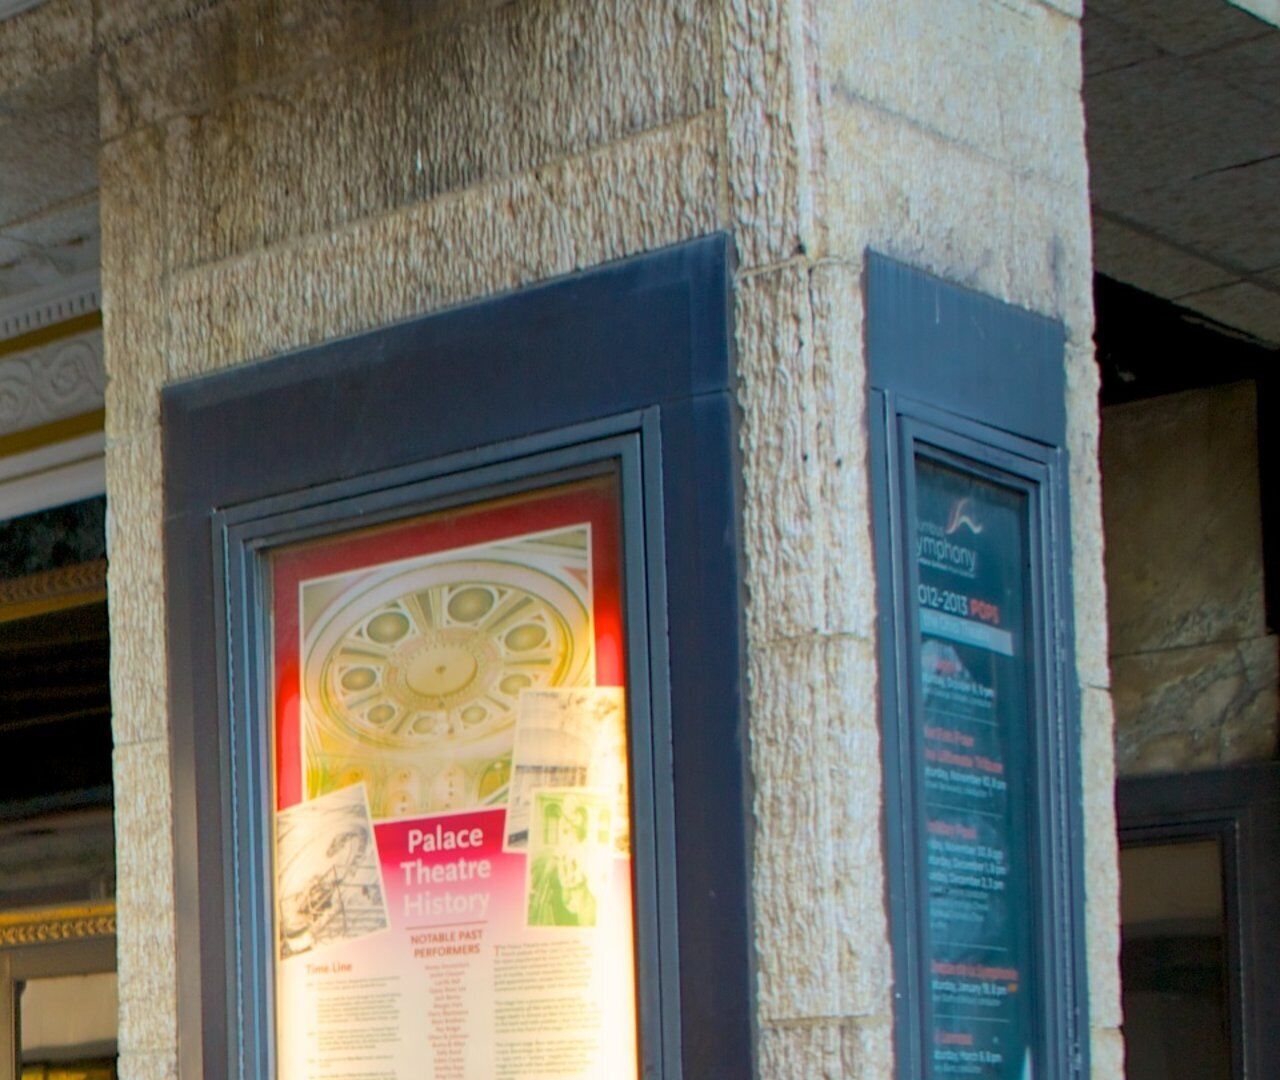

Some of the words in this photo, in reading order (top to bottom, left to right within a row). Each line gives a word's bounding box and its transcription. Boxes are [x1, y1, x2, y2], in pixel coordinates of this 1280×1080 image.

[917, 535, 977, 572] ymphony
[918, 584, 969, 617] 012-2013
[408, 824, 484, 854] Palace
[400, 857, 492, 886] Theatre
[403, 890, 490, 919] History
[411, 932, 455, 945] NOTABLE
[459, 930, 483, 940] PAST
[414, 945, 481, 958] PERFORMERS
[306, 963, 329, 975] Time
[333, 961, 352, 973] Line
